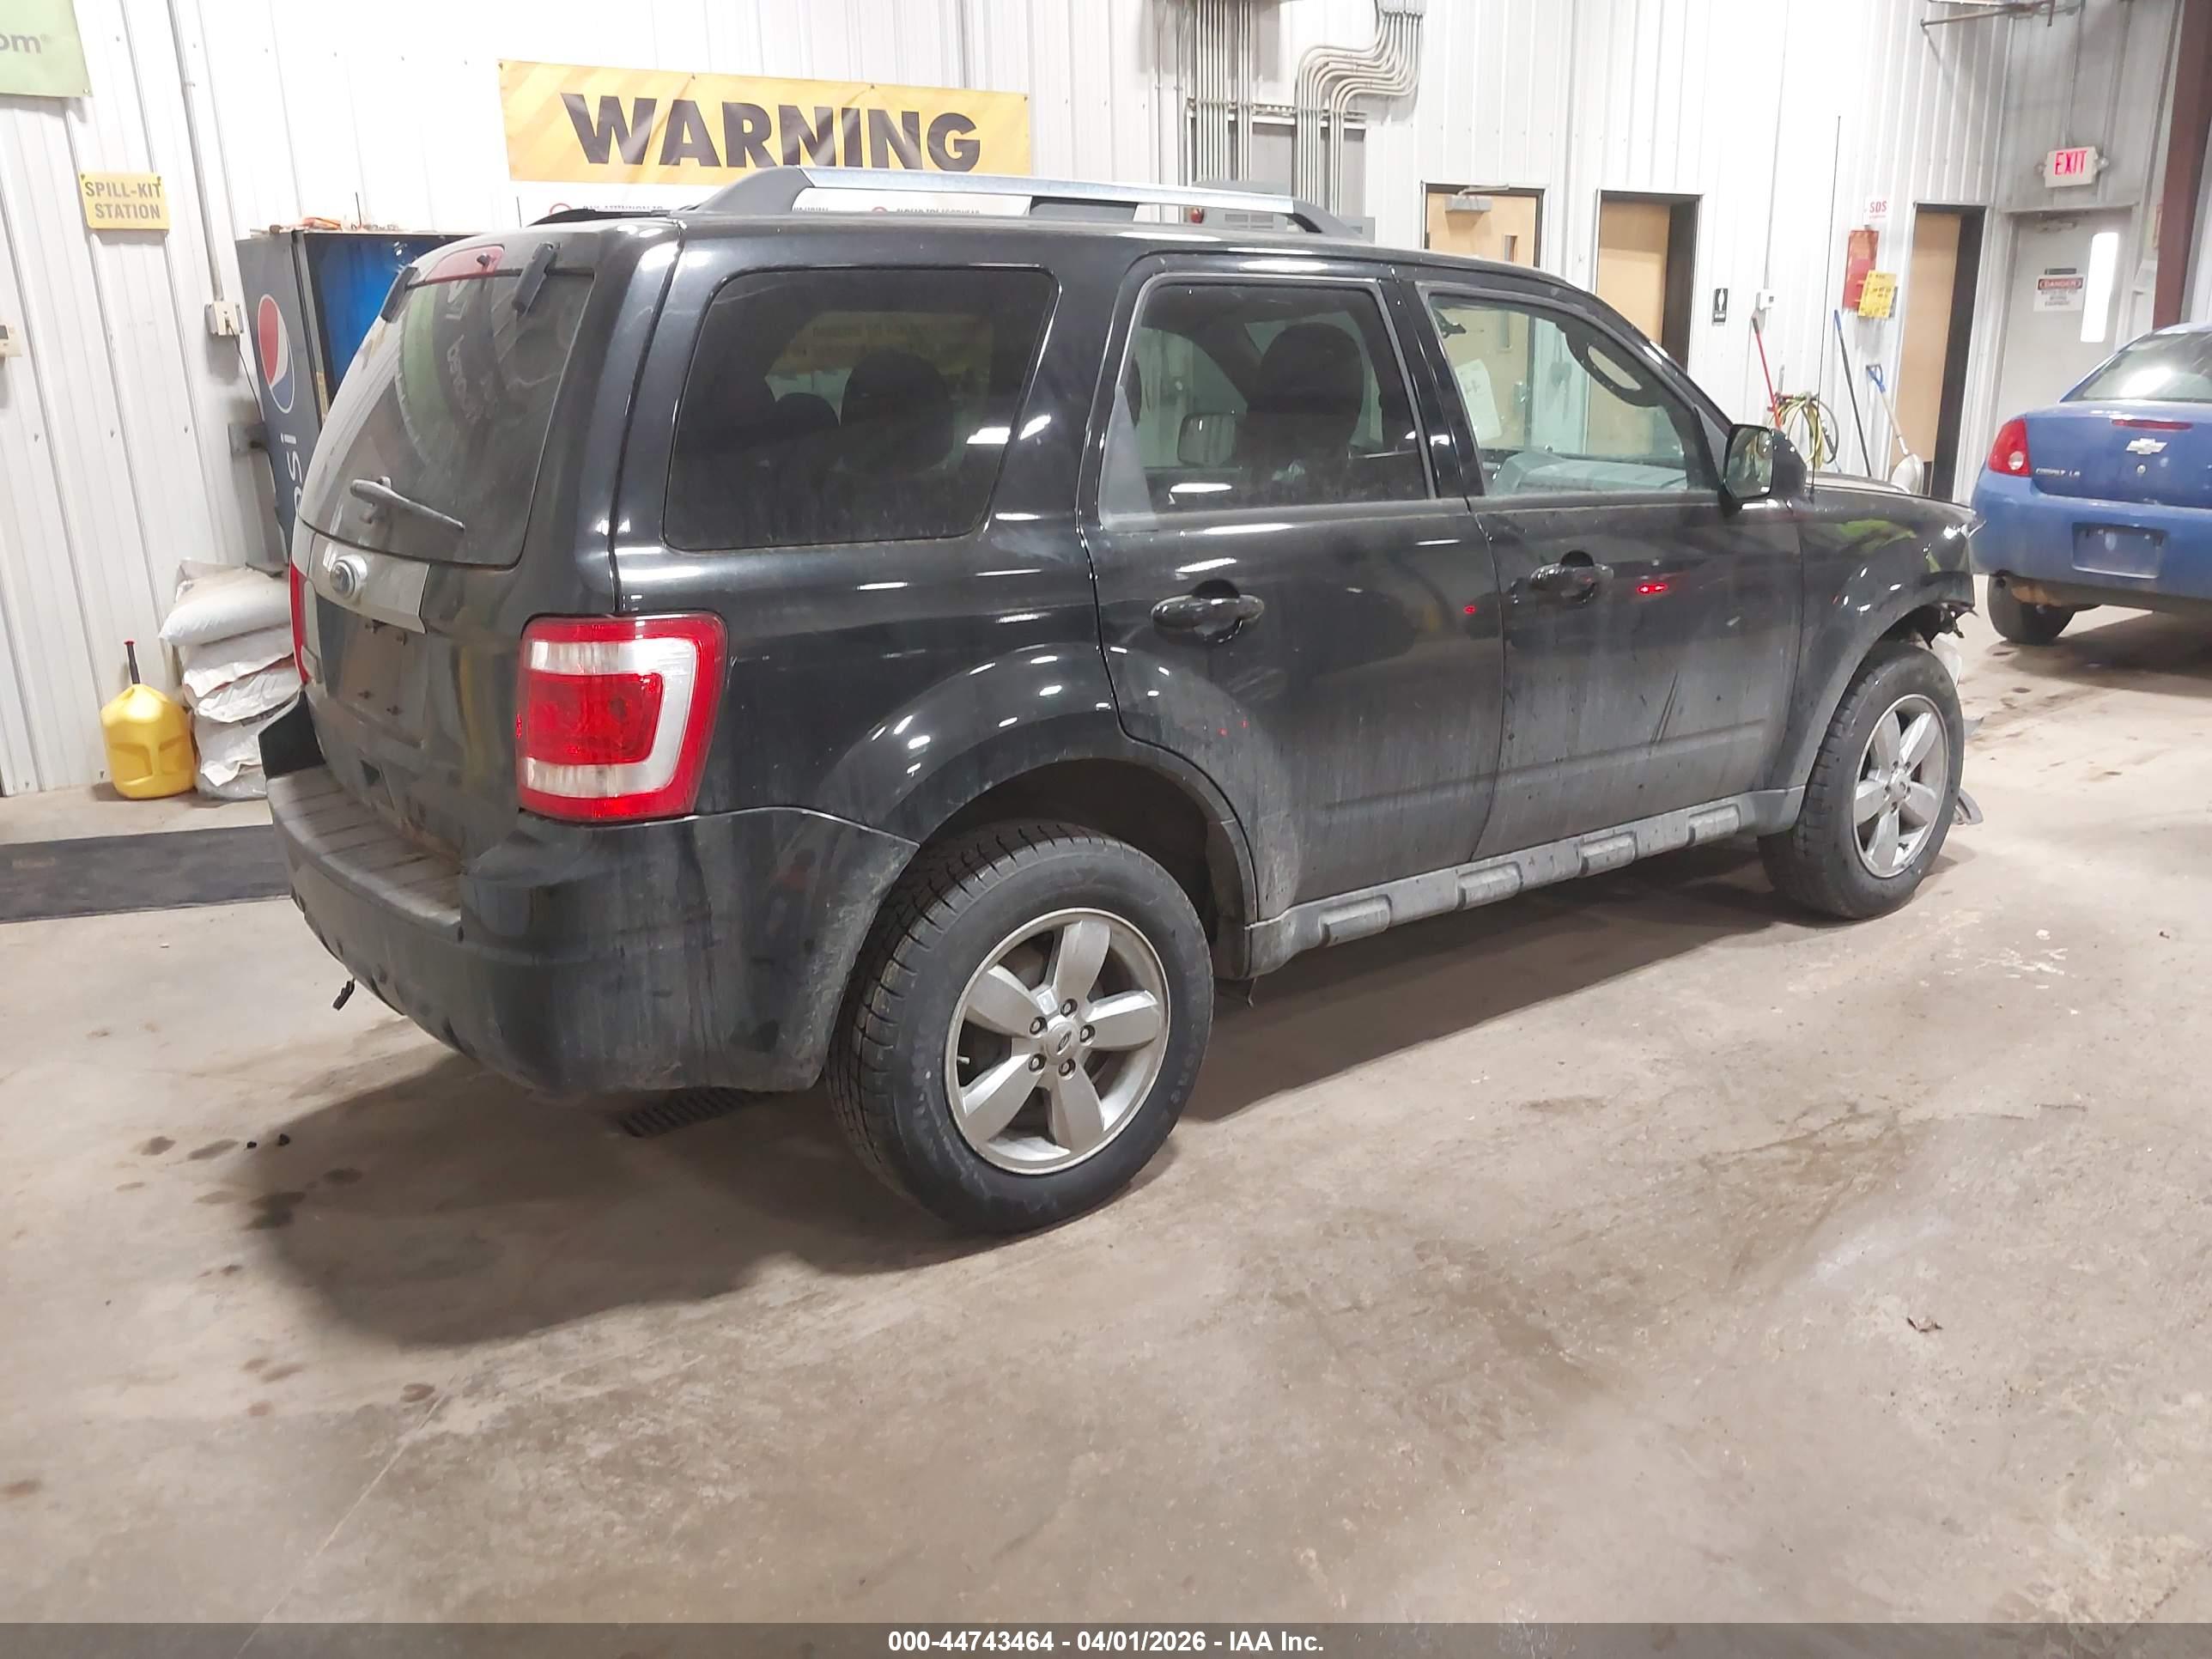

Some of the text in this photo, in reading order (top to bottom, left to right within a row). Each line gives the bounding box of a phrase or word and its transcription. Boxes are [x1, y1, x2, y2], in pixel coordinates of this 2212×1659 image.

[560, 92, 981, 172] WARNING
[2055, 150, 2087, 175] EXIT
[85, 181, 161, 198] SPILL-KIT
[95, 203, 161, 219] STATION
[1869, 200, 1887, 213] SDS
